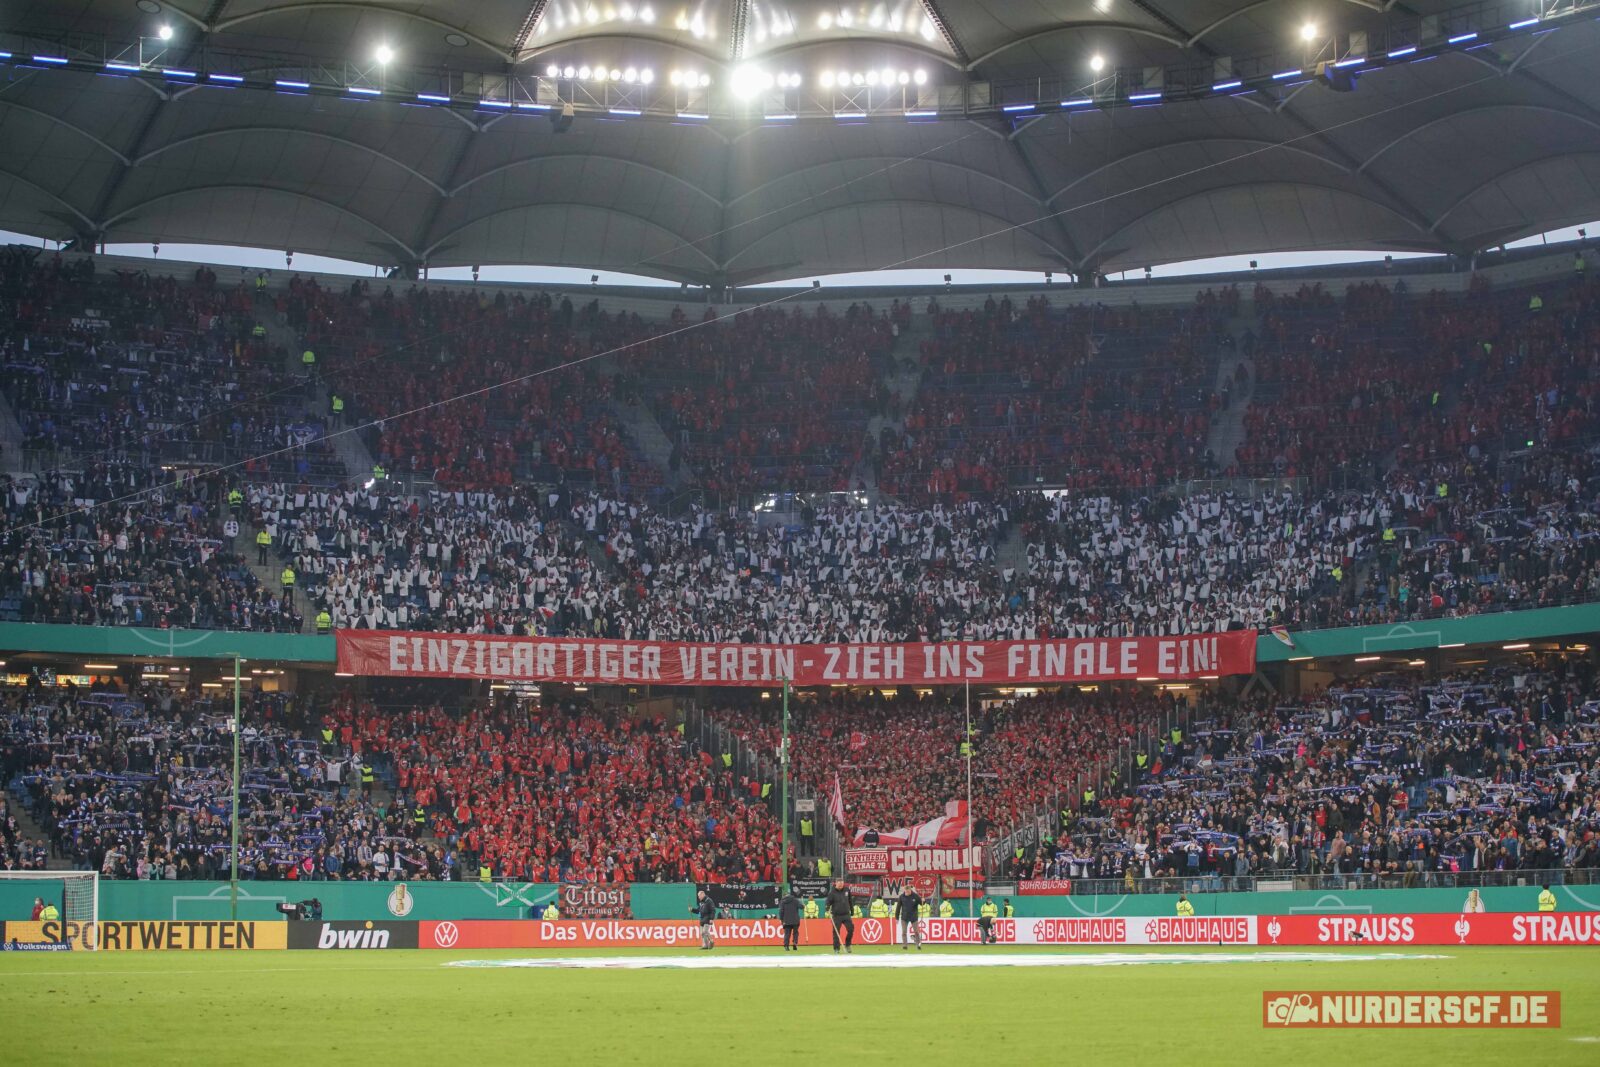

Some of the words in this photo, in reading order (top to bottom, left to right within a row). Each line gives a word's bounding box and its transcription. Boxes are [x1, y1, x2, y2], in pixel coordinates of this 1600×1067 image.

[389, 635, 662, 682] EINZIGARTIGER
[680, 645, 795, 682] VEREIN
[823, 645, 905, 680] ZIEH
[922, 644, 985, 679] INS
[1008, 641, 1138, 678] FINALE
[1158, 637, 1219, 674] EIN!
[846, 853, 887, 862] SYNTHESIA
[848, 862, 875, 870] ULTRAS
[891, 846, 982, 872] CORRILLO
[565, 885, 625, 905] Tifosi
[1020, 880, 1069, 890] SUHR/BUCHS
[42, 921, 254, 950] SPORTWETTEN
[319, 921, 390, 949] bwin
[541, 922, 577, 941] Das
[581, 921, 699, 947] Volkswagen
[930, 920, 1015, 941] BAUHUS
[1045, 920, 1126, 941] BAUHAUS
[1158, 919, 1249, 942] BAUHAUS
[1318, 916, 1415, 942] STRAUSS
[17, 943, 67, 951] Volkswagen
